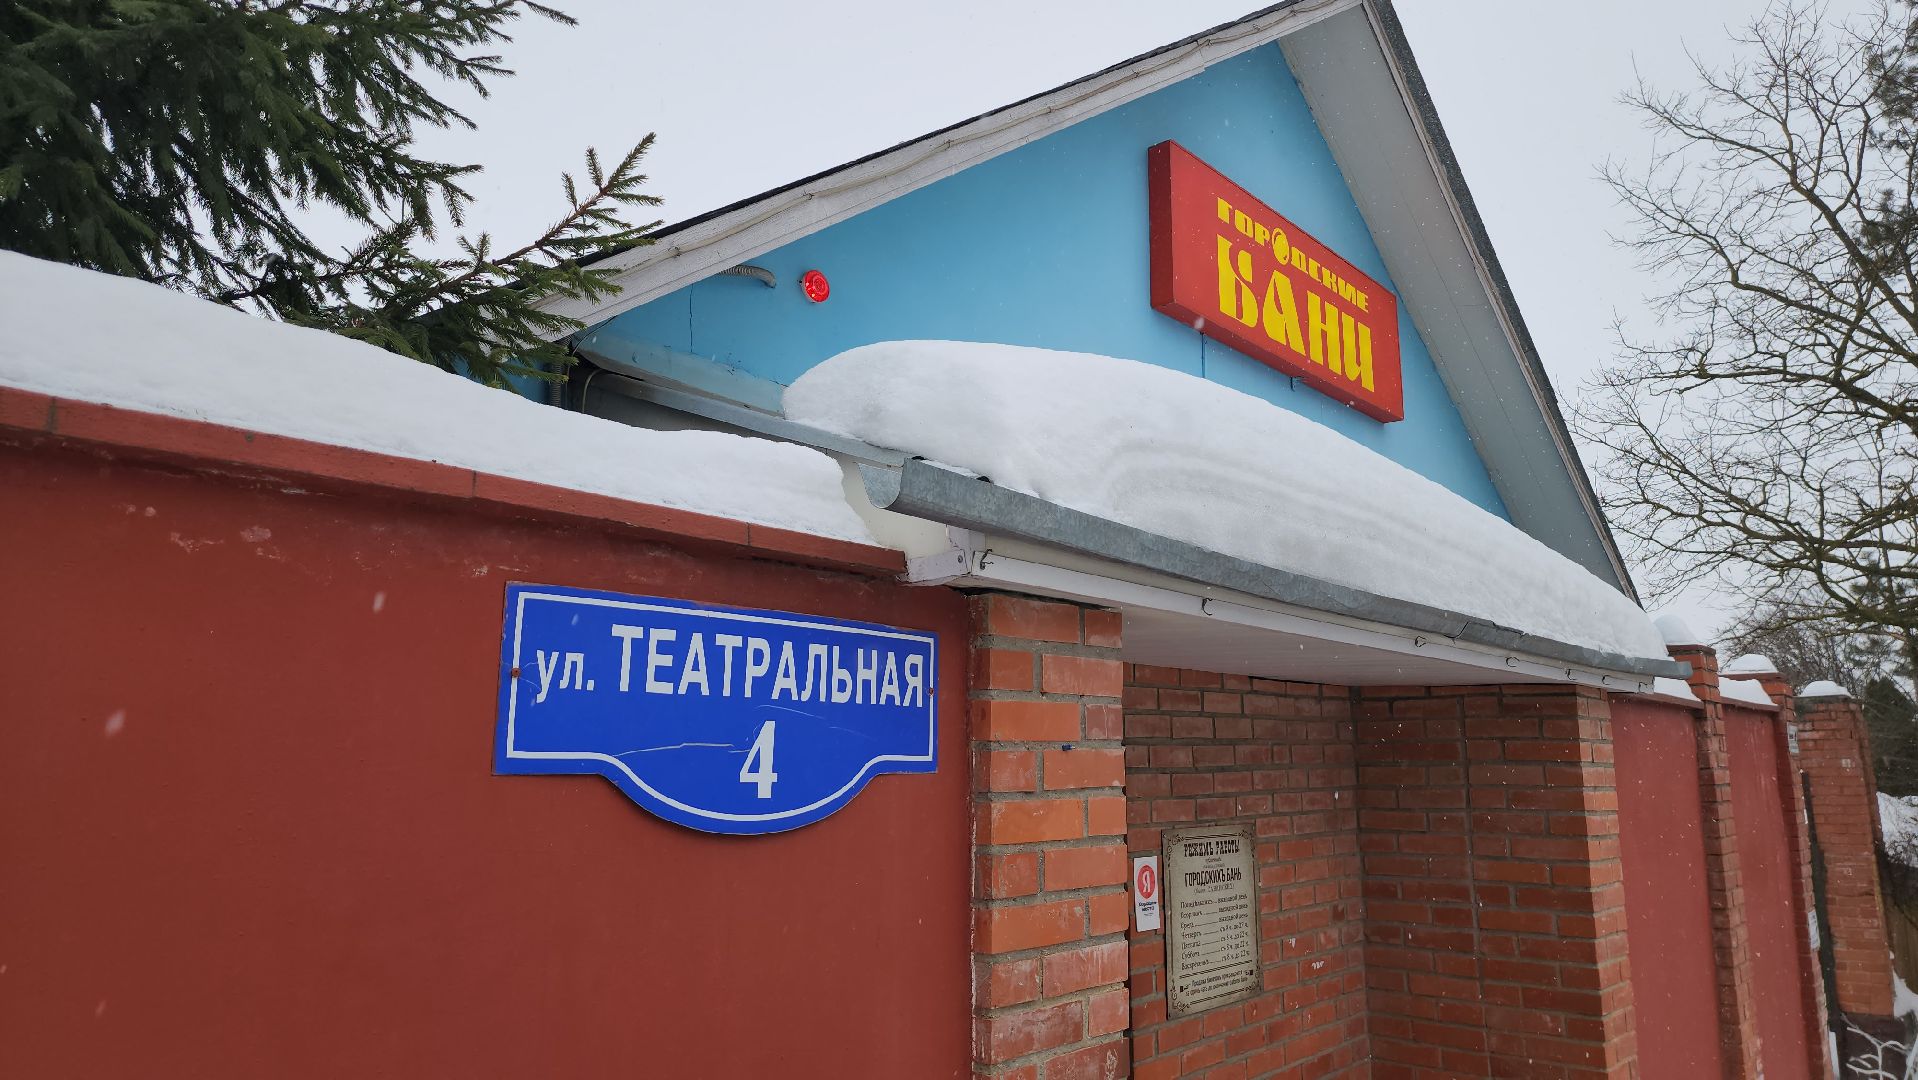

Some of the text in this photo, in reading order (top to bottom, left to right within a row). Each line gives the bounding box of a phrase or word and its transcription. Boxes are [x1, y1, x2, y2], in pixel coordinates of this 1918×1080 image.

[1217, 197, 1369, 313] ГОРОДСКИЕ
[1217, 234, 1374, 392] БАНИ
[536, 623, 924, 708] ул. ТЕАТРАЛЬНАЯ
[739, 720, 778, 799] 4
[1184, 867, 1242, 887] ГОРОДСКИХЪ БАНЬ
